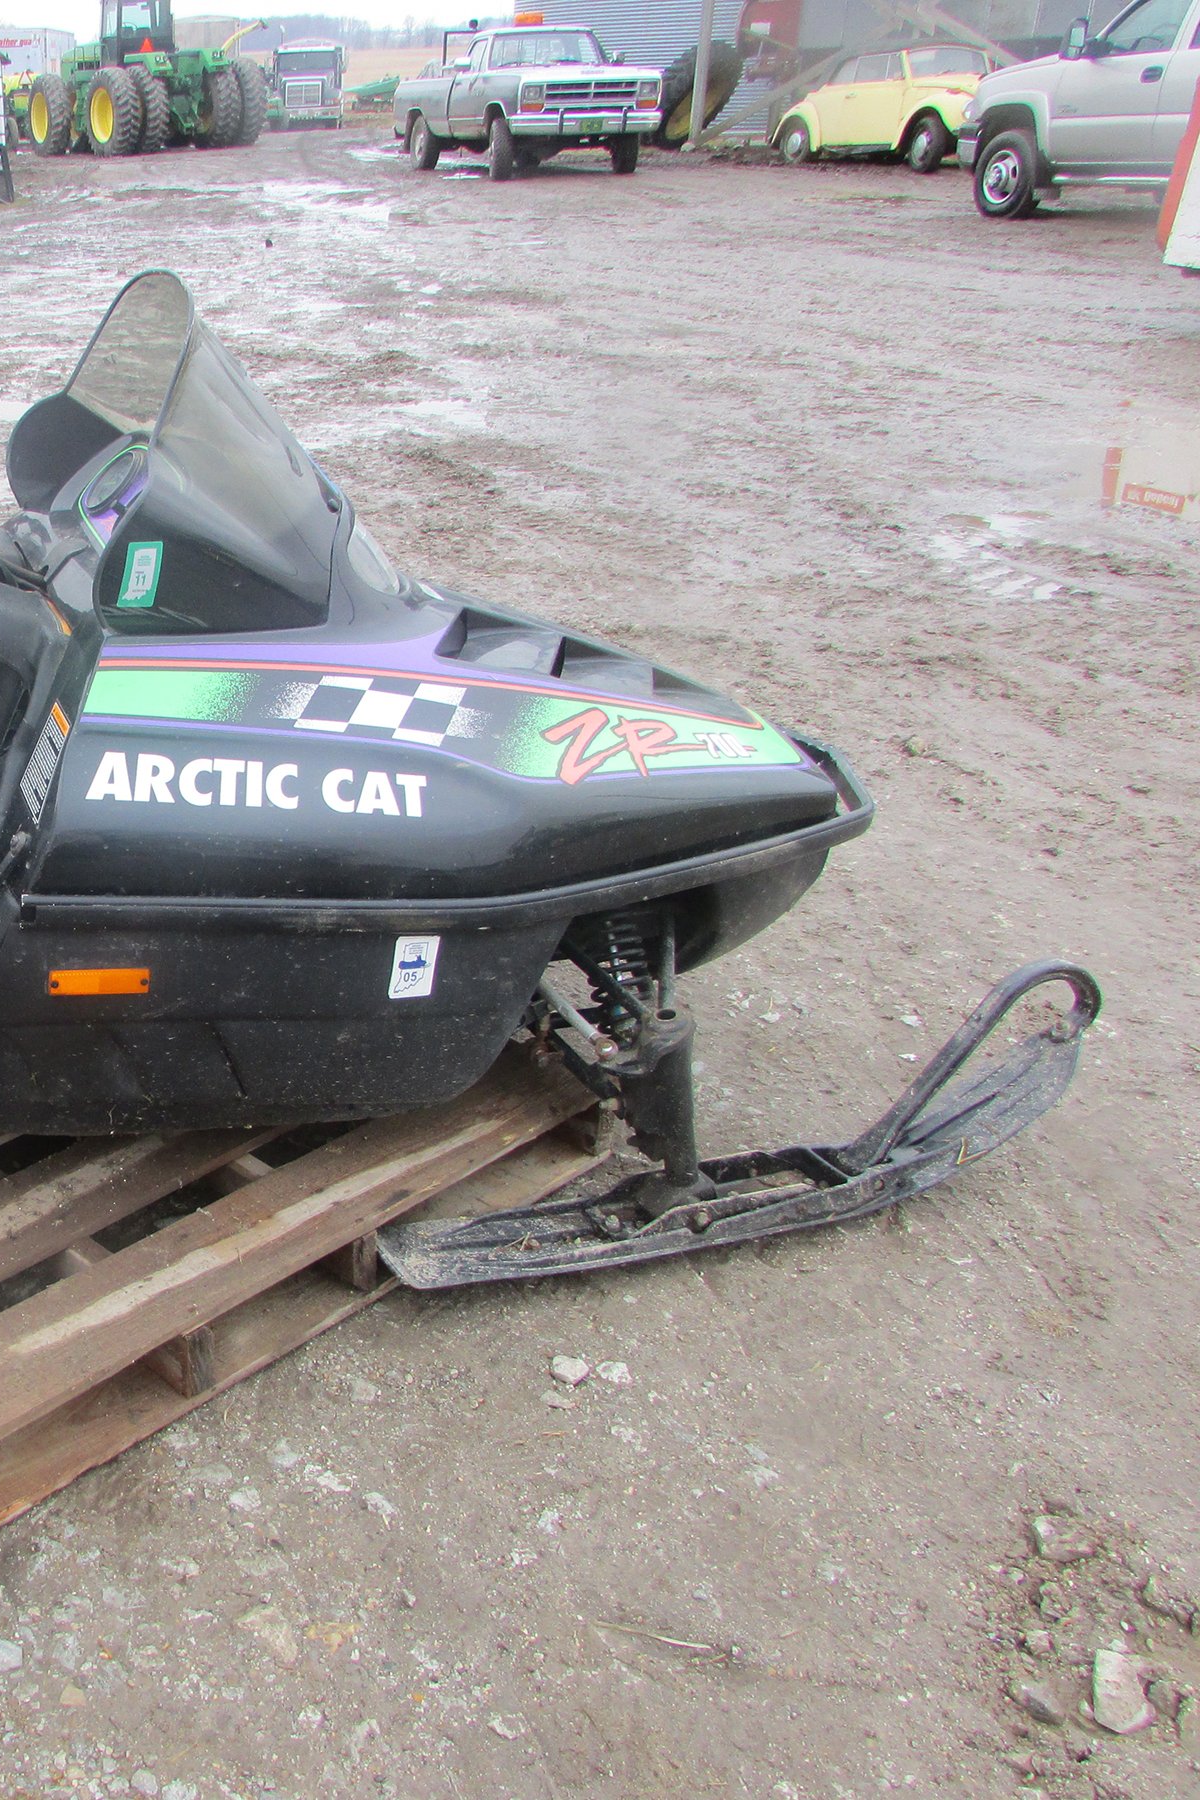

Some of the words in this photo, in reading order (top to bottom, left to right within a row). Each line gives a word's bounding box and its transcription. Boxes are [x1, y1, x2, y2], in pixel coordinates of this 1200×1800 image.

[135, 574, 146, 586] 11
[540, 707, 692, 786] ZR
[85, 751, 299, 810] ARCTIC
[322, 768, 427, 818] CAT
[403, 971, 417, 983] 05
